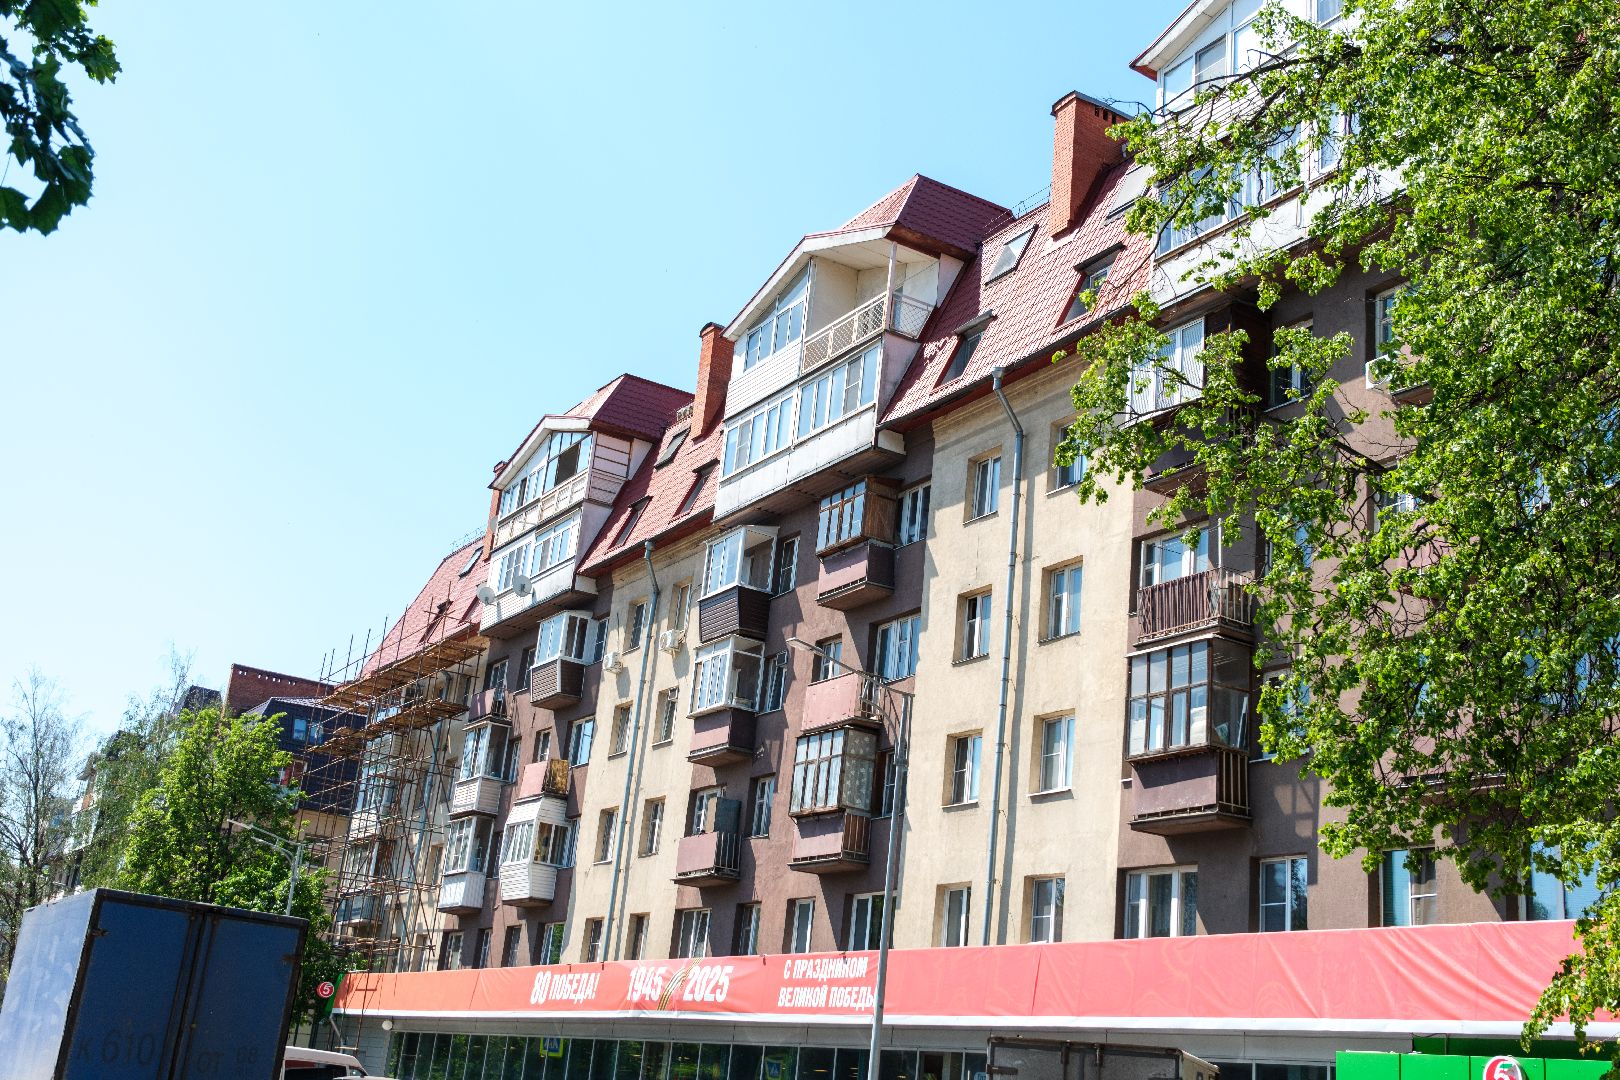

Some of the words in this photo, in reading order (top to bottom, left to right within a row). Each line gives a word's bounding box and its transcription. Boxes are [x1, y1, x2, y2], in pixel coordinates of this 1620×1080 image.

[626, 966, 668, 1001] 1945
[682, 965, 735, 1002] 2025
[784, 959, 792, 979] С
[793, 957, 869, 981] ПРАЗДНИКОМ
[530, 971, 551, 1005] 80
[550, 972, 600, 1004] ПОБЕДА!
[778, 985, 828, 1008] ВЕЛИКОЙ
